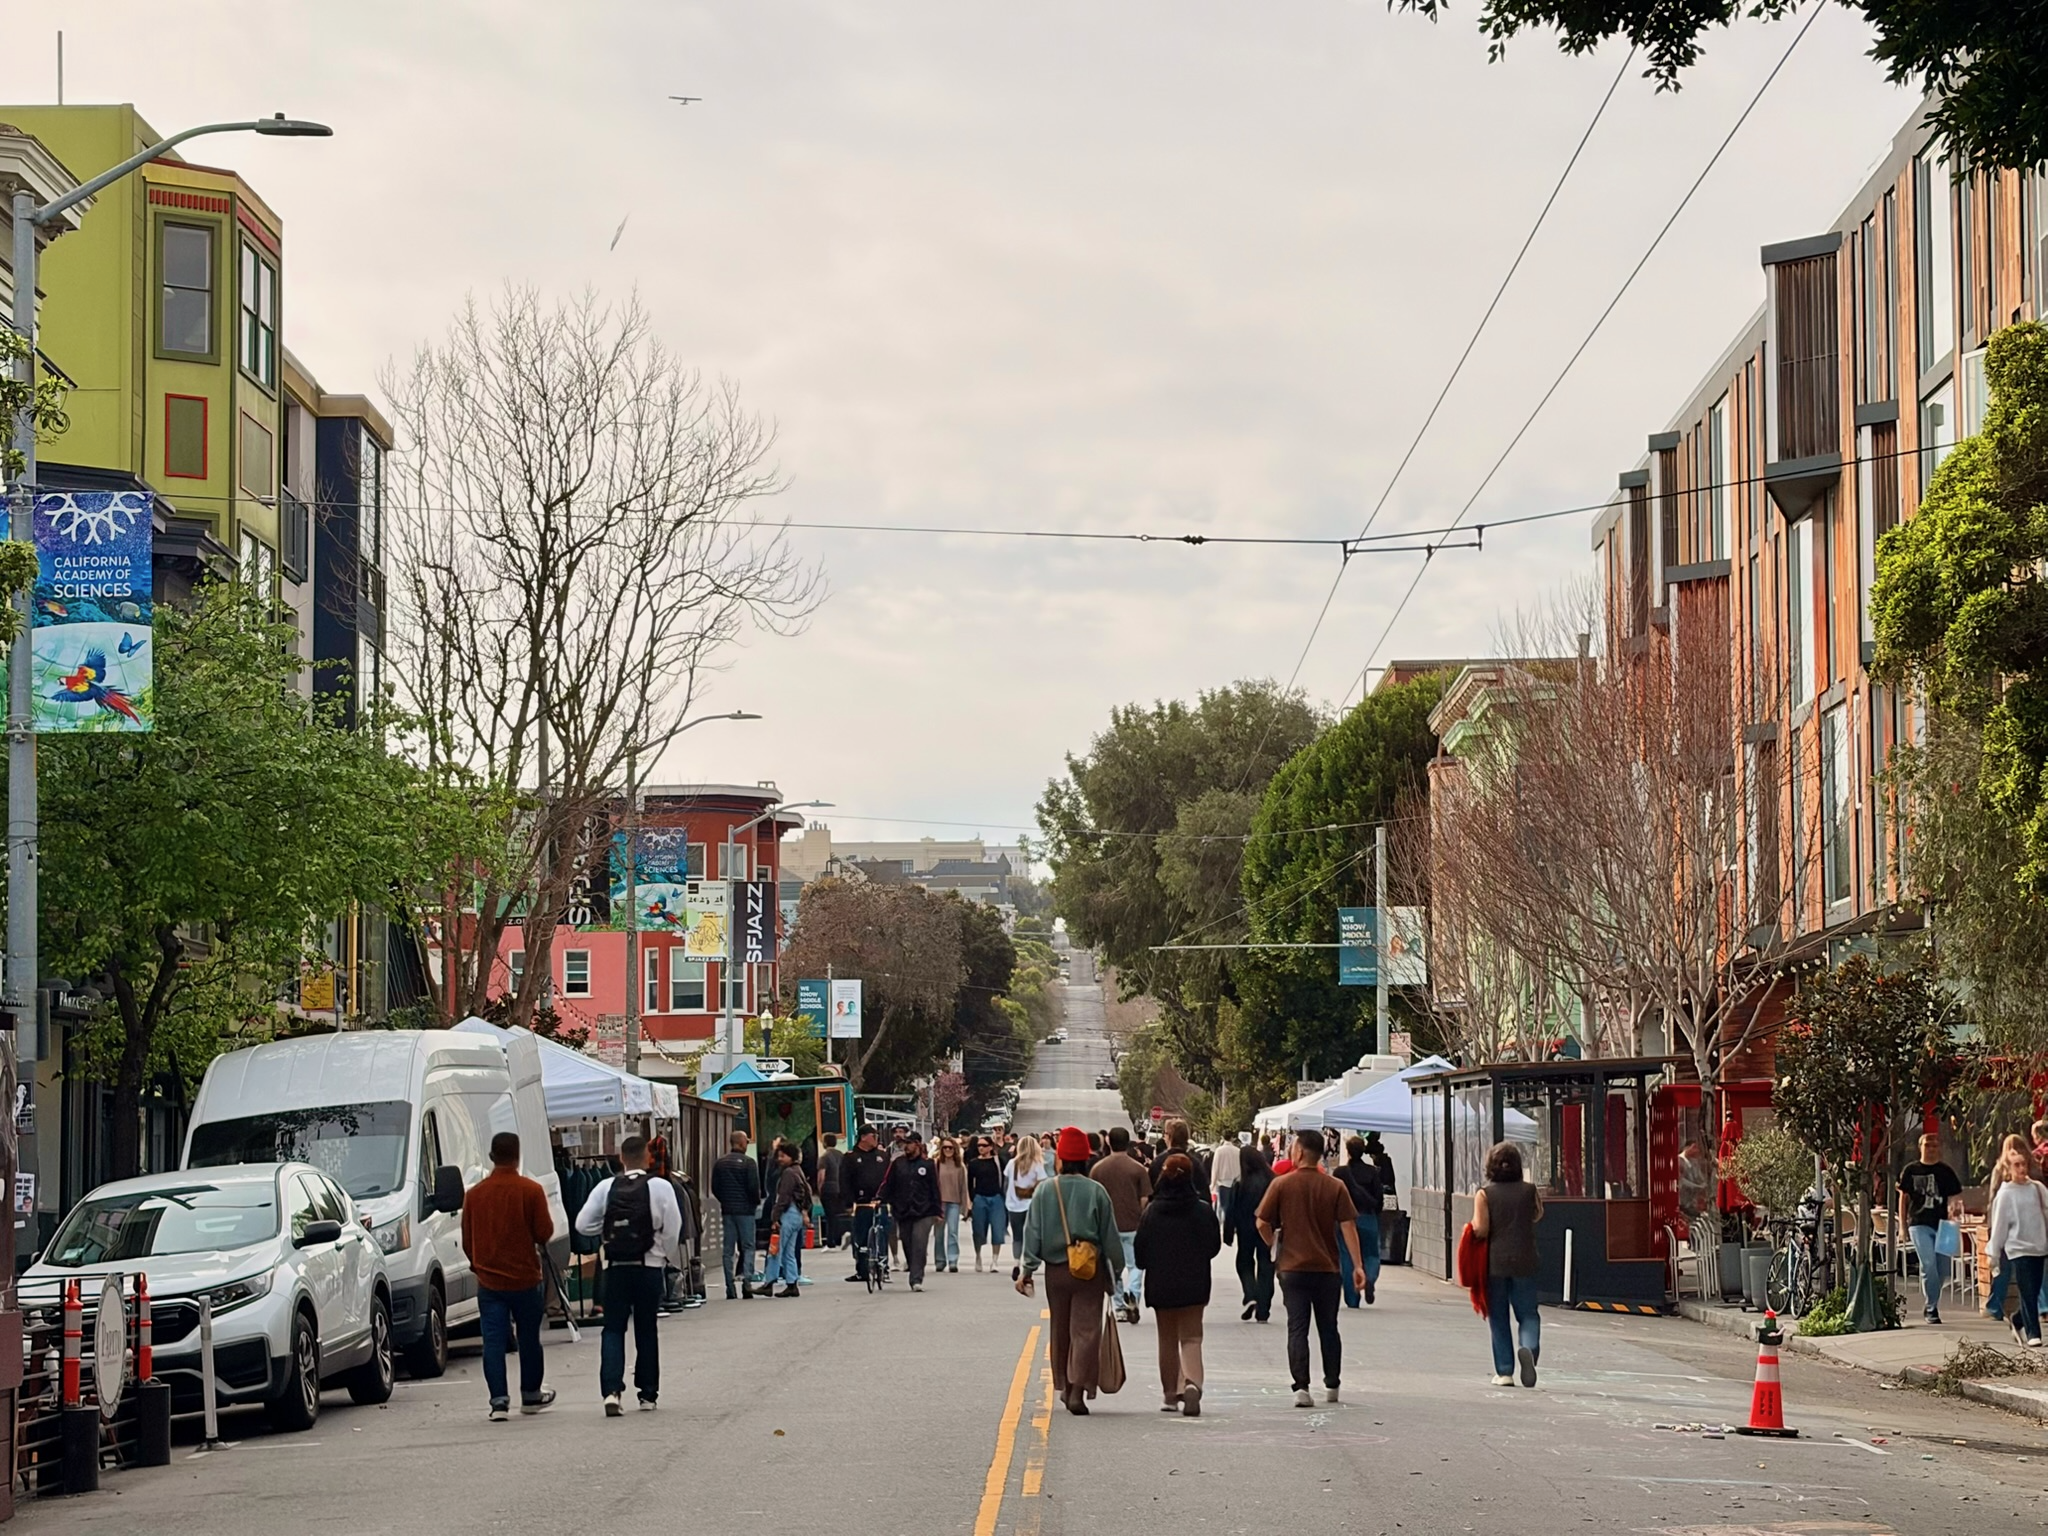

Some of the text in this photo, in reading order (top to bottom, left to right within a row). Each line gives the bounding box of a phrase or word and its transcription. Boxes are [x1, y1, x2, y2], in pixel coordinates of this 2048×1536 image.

[54, 556, 131, 568] CALIFORNIA
[54, 569, 131, 581] ACADEMY OF
[54, 583, 132, 598] SCIENCES
[746, 882, 763, 963] SFJAZZ
